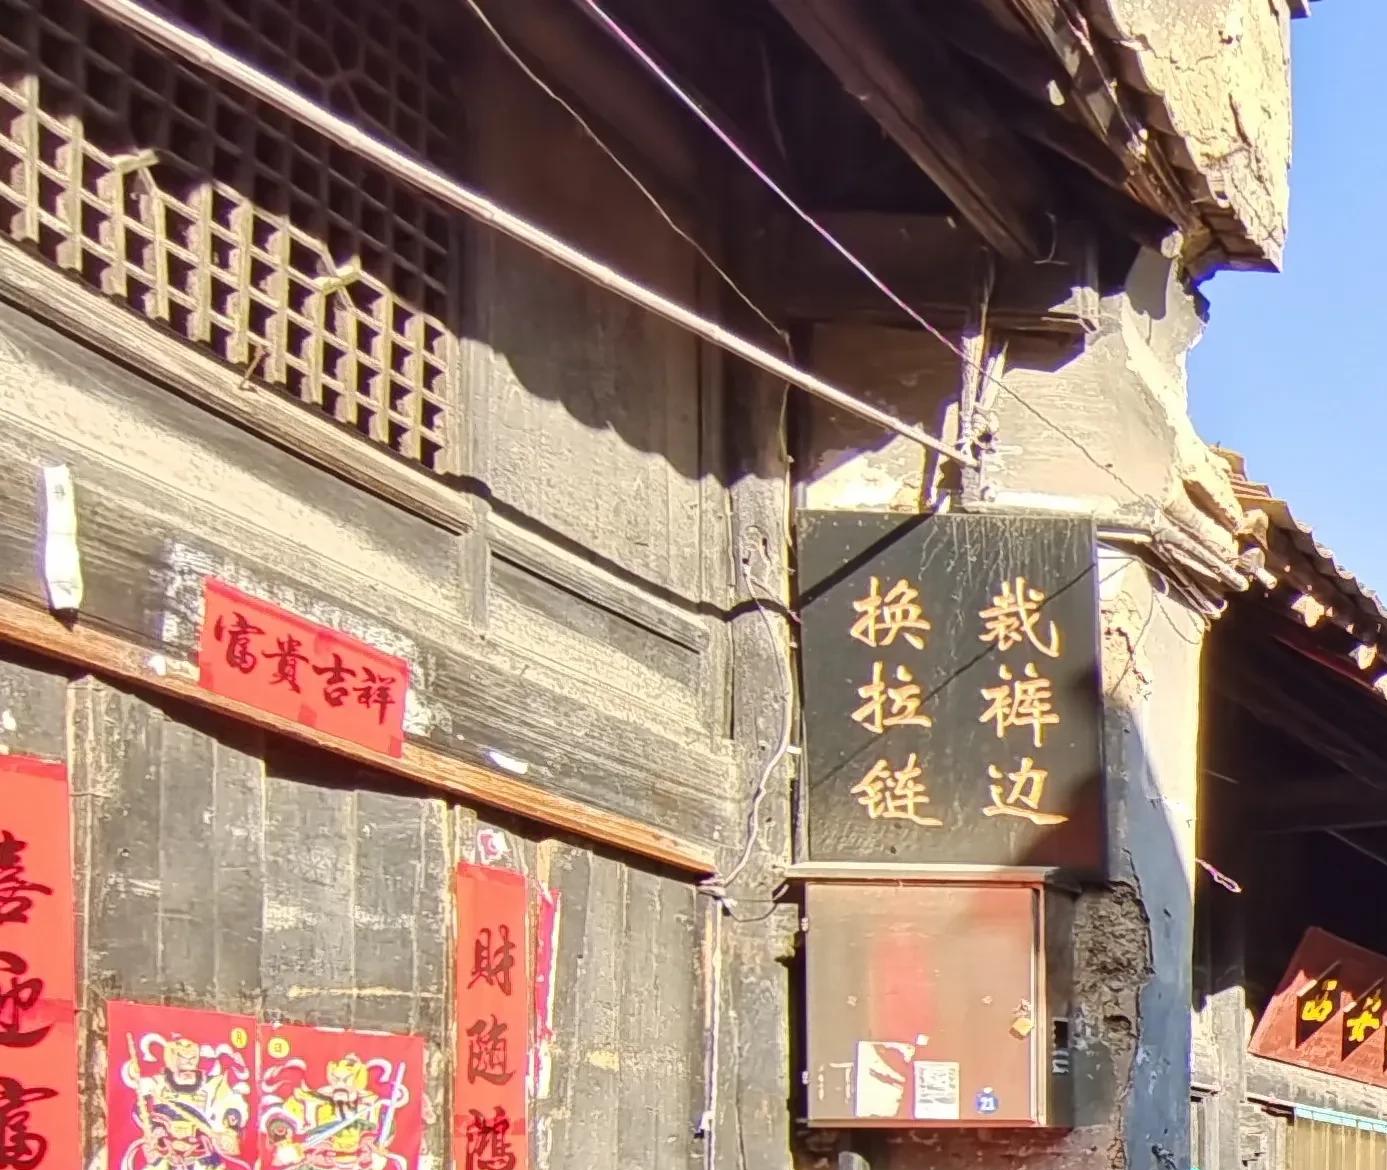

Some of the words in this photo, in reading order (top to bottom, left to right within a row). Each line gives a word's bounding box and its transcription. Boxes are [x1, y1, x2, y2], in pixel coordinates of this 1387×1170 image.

[214, 611, 396, 725] 富貴吉祥
[849, 577, 943, 826] 换拉链
[978, 577, 1069, 826] 裁裤边
